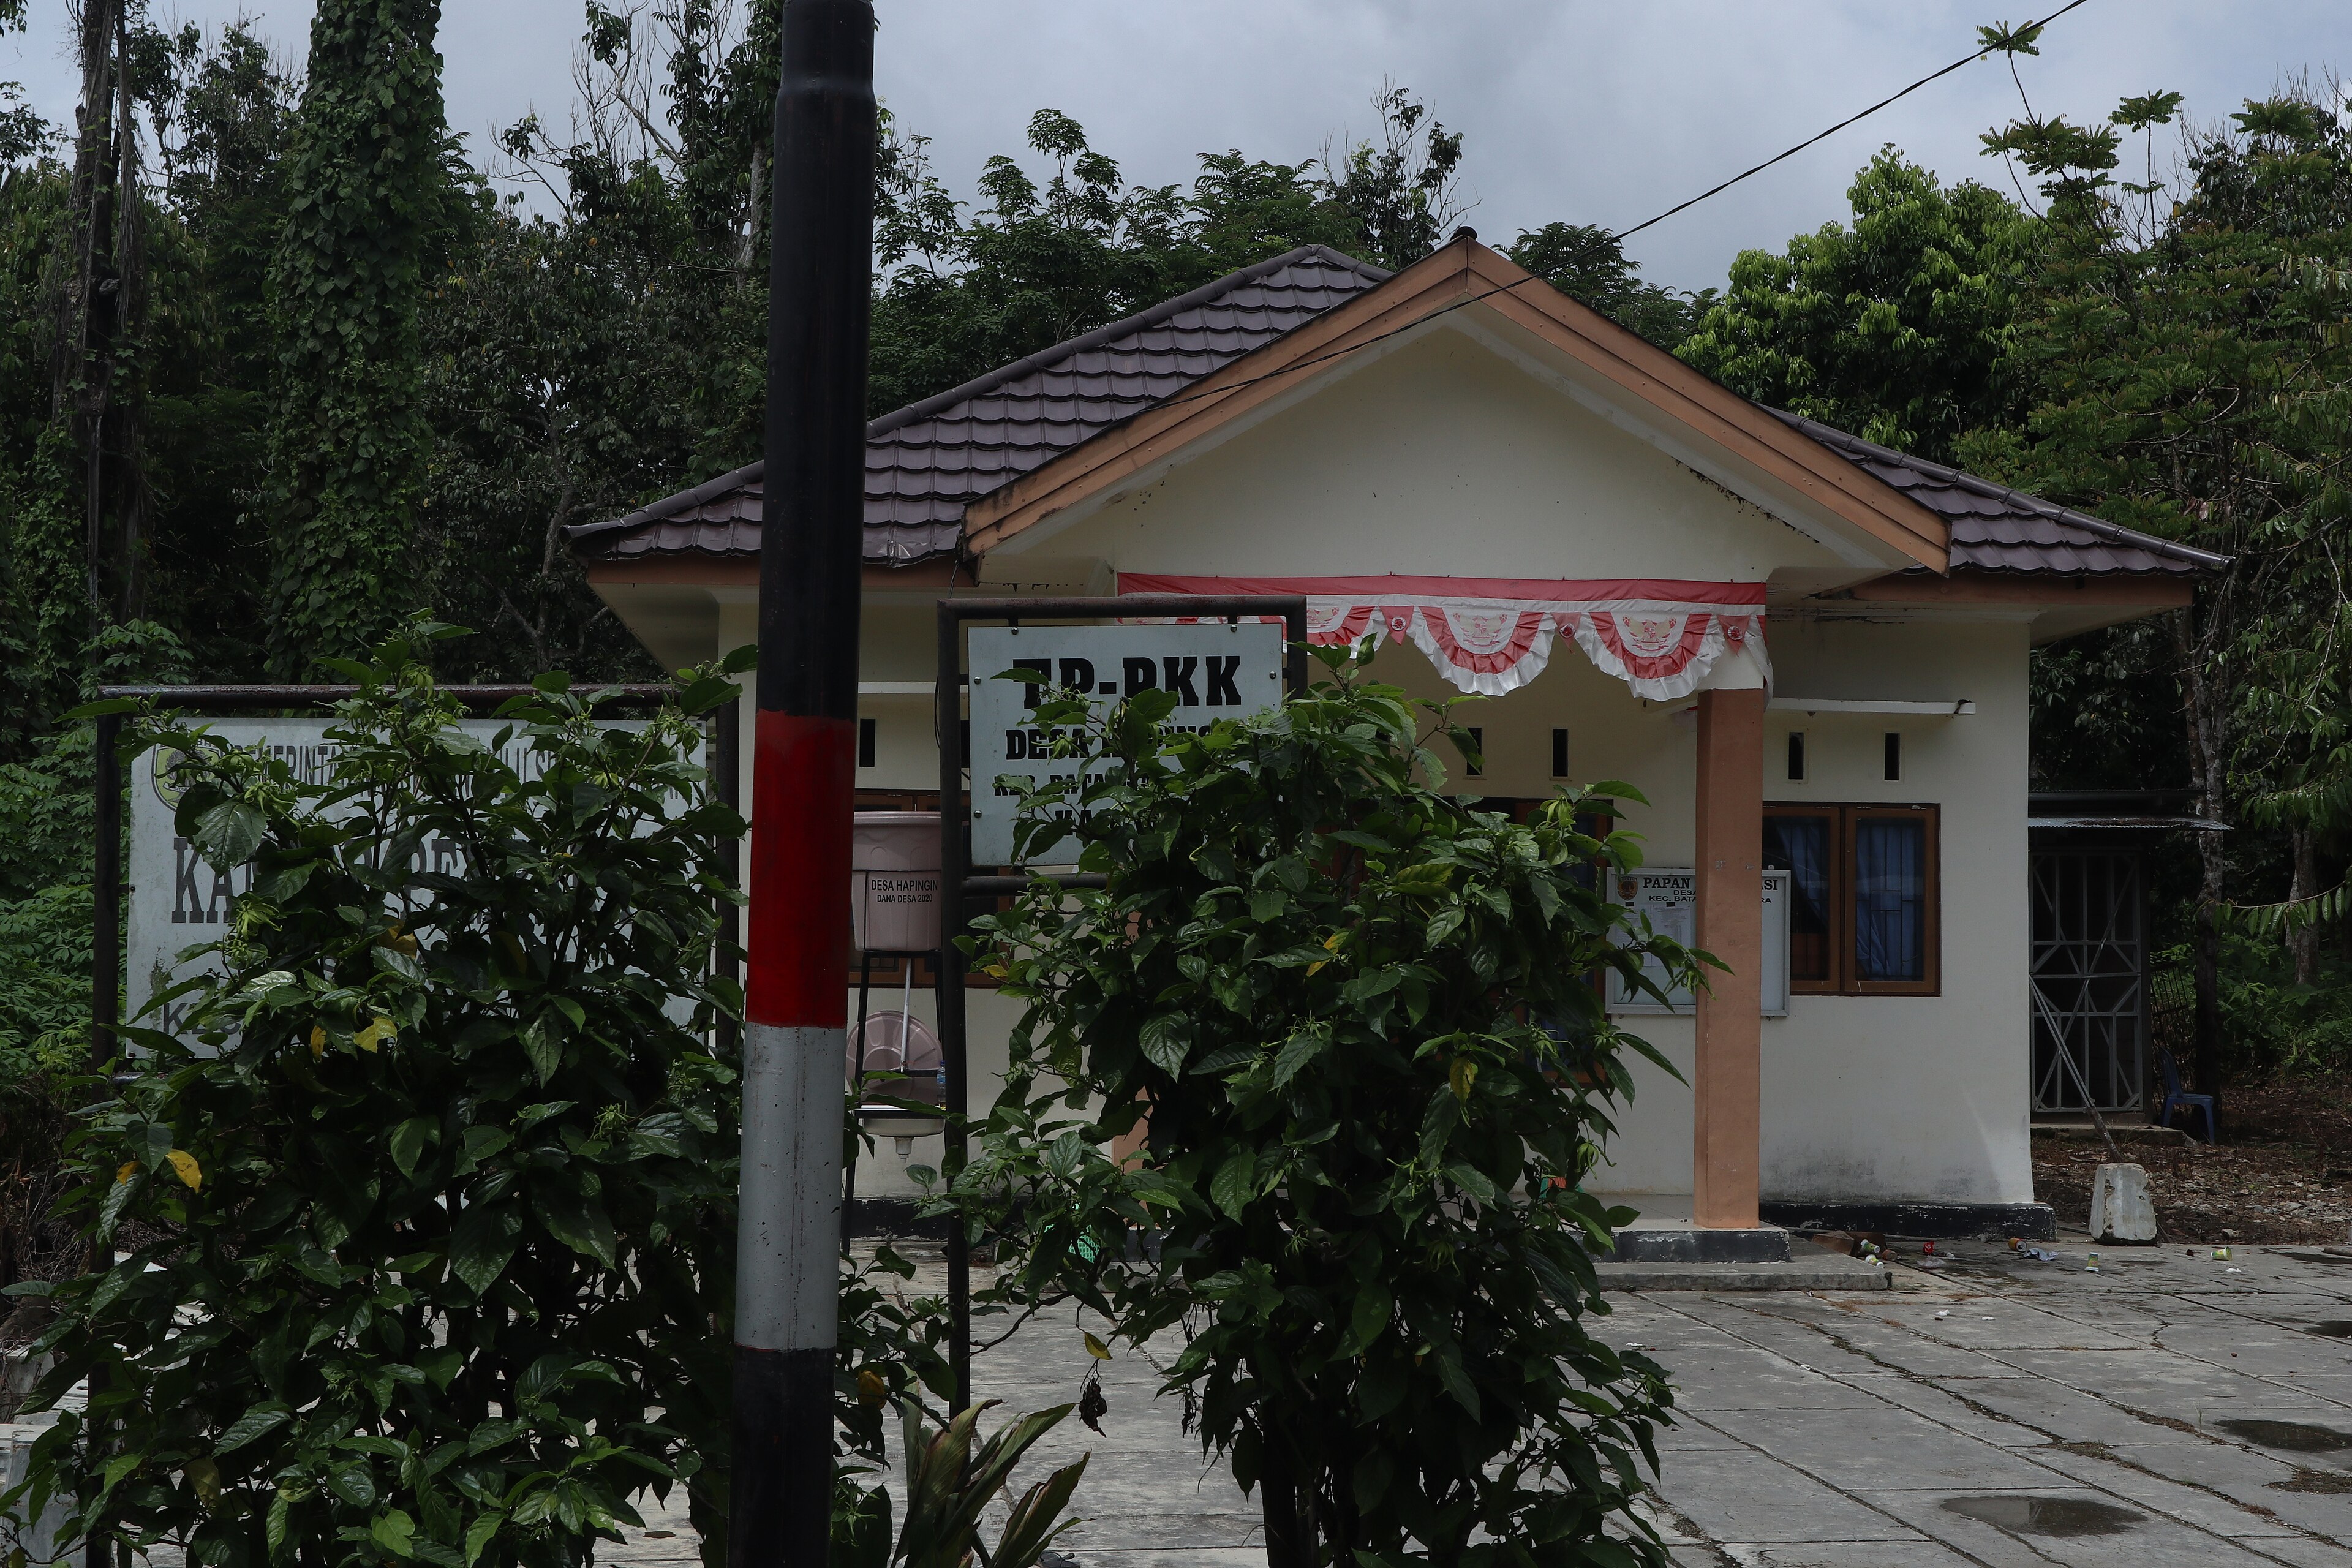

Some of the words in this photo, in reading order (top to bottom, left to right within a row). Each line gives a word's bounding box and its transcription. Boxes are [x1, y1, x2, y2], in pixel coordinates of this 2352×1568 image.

[1012, 655, 1242, 709] TP-PKK
[872, 880, 894, 891] DESA
[896, 880, 938, 891] HAPINGIN
[1643, 877, 1691, 889] PAPAN
[877, 894, 895, 903] DANA
[918, 894, 933, 902] 2020
